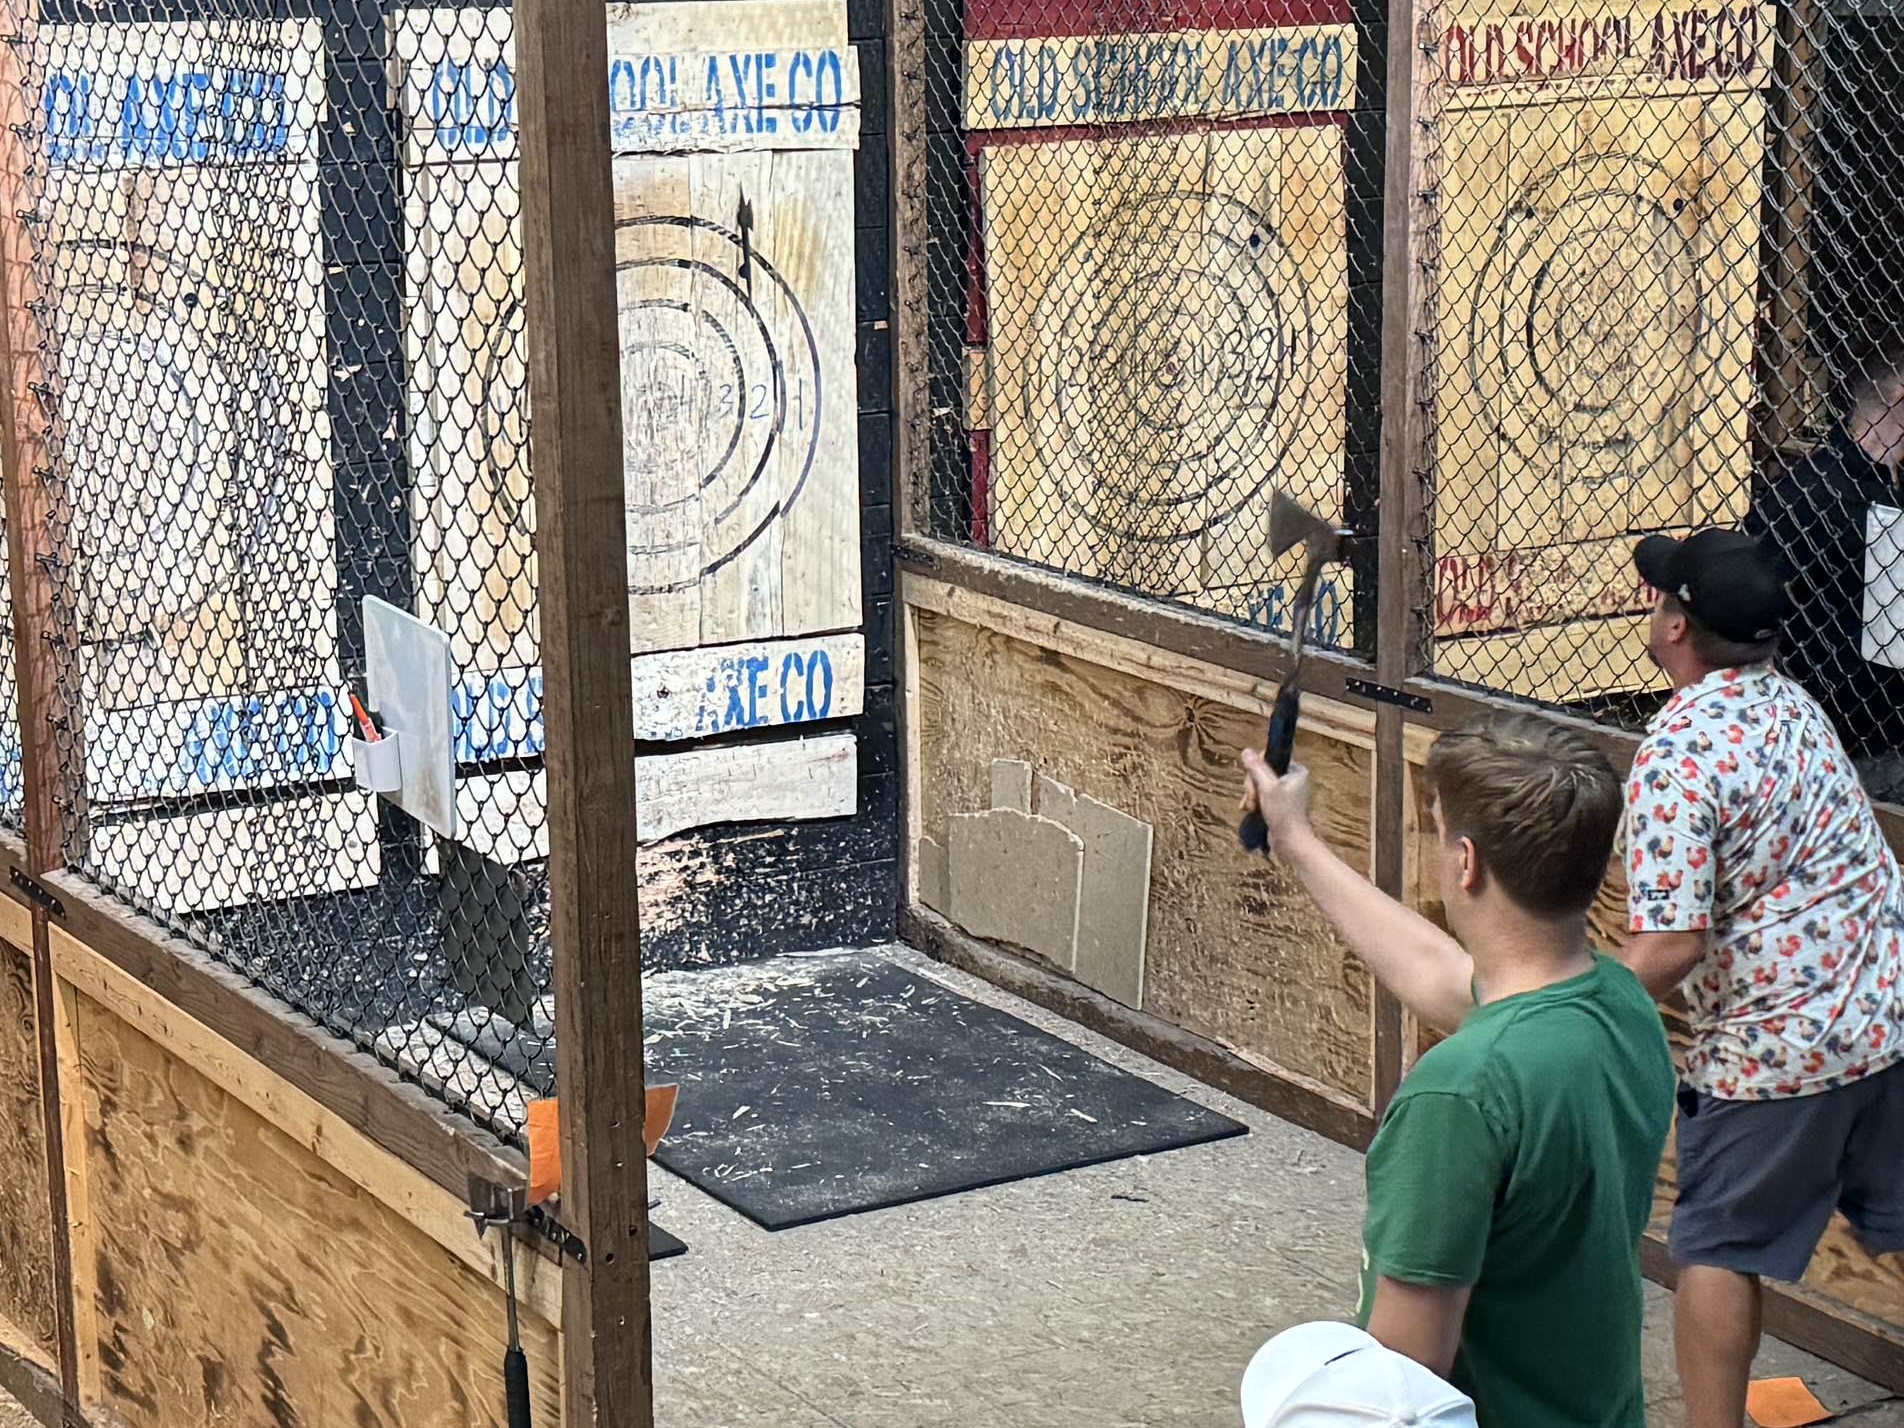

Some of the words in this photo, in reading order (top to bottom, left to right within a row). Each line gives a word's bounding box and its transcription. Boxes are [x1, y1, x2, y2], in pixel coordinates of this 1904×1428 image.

[990, 41, 1059, 121] OLD
[1220, 35, 1285, 110] AXE
[1295, 33, 1343, 108] CO
[1444, 24, 1504, 83] OLD
[1649, 8, 1708, 81] AXE
[432, 59, 513, 147] OLD
[704, 52, 778, 134] AXE
[788, 49, 843, 133] CO
[1253, 326, 1275, 381] 2
[749, 384, 770, 419] 2
[780, 649, 834, 723] CO
